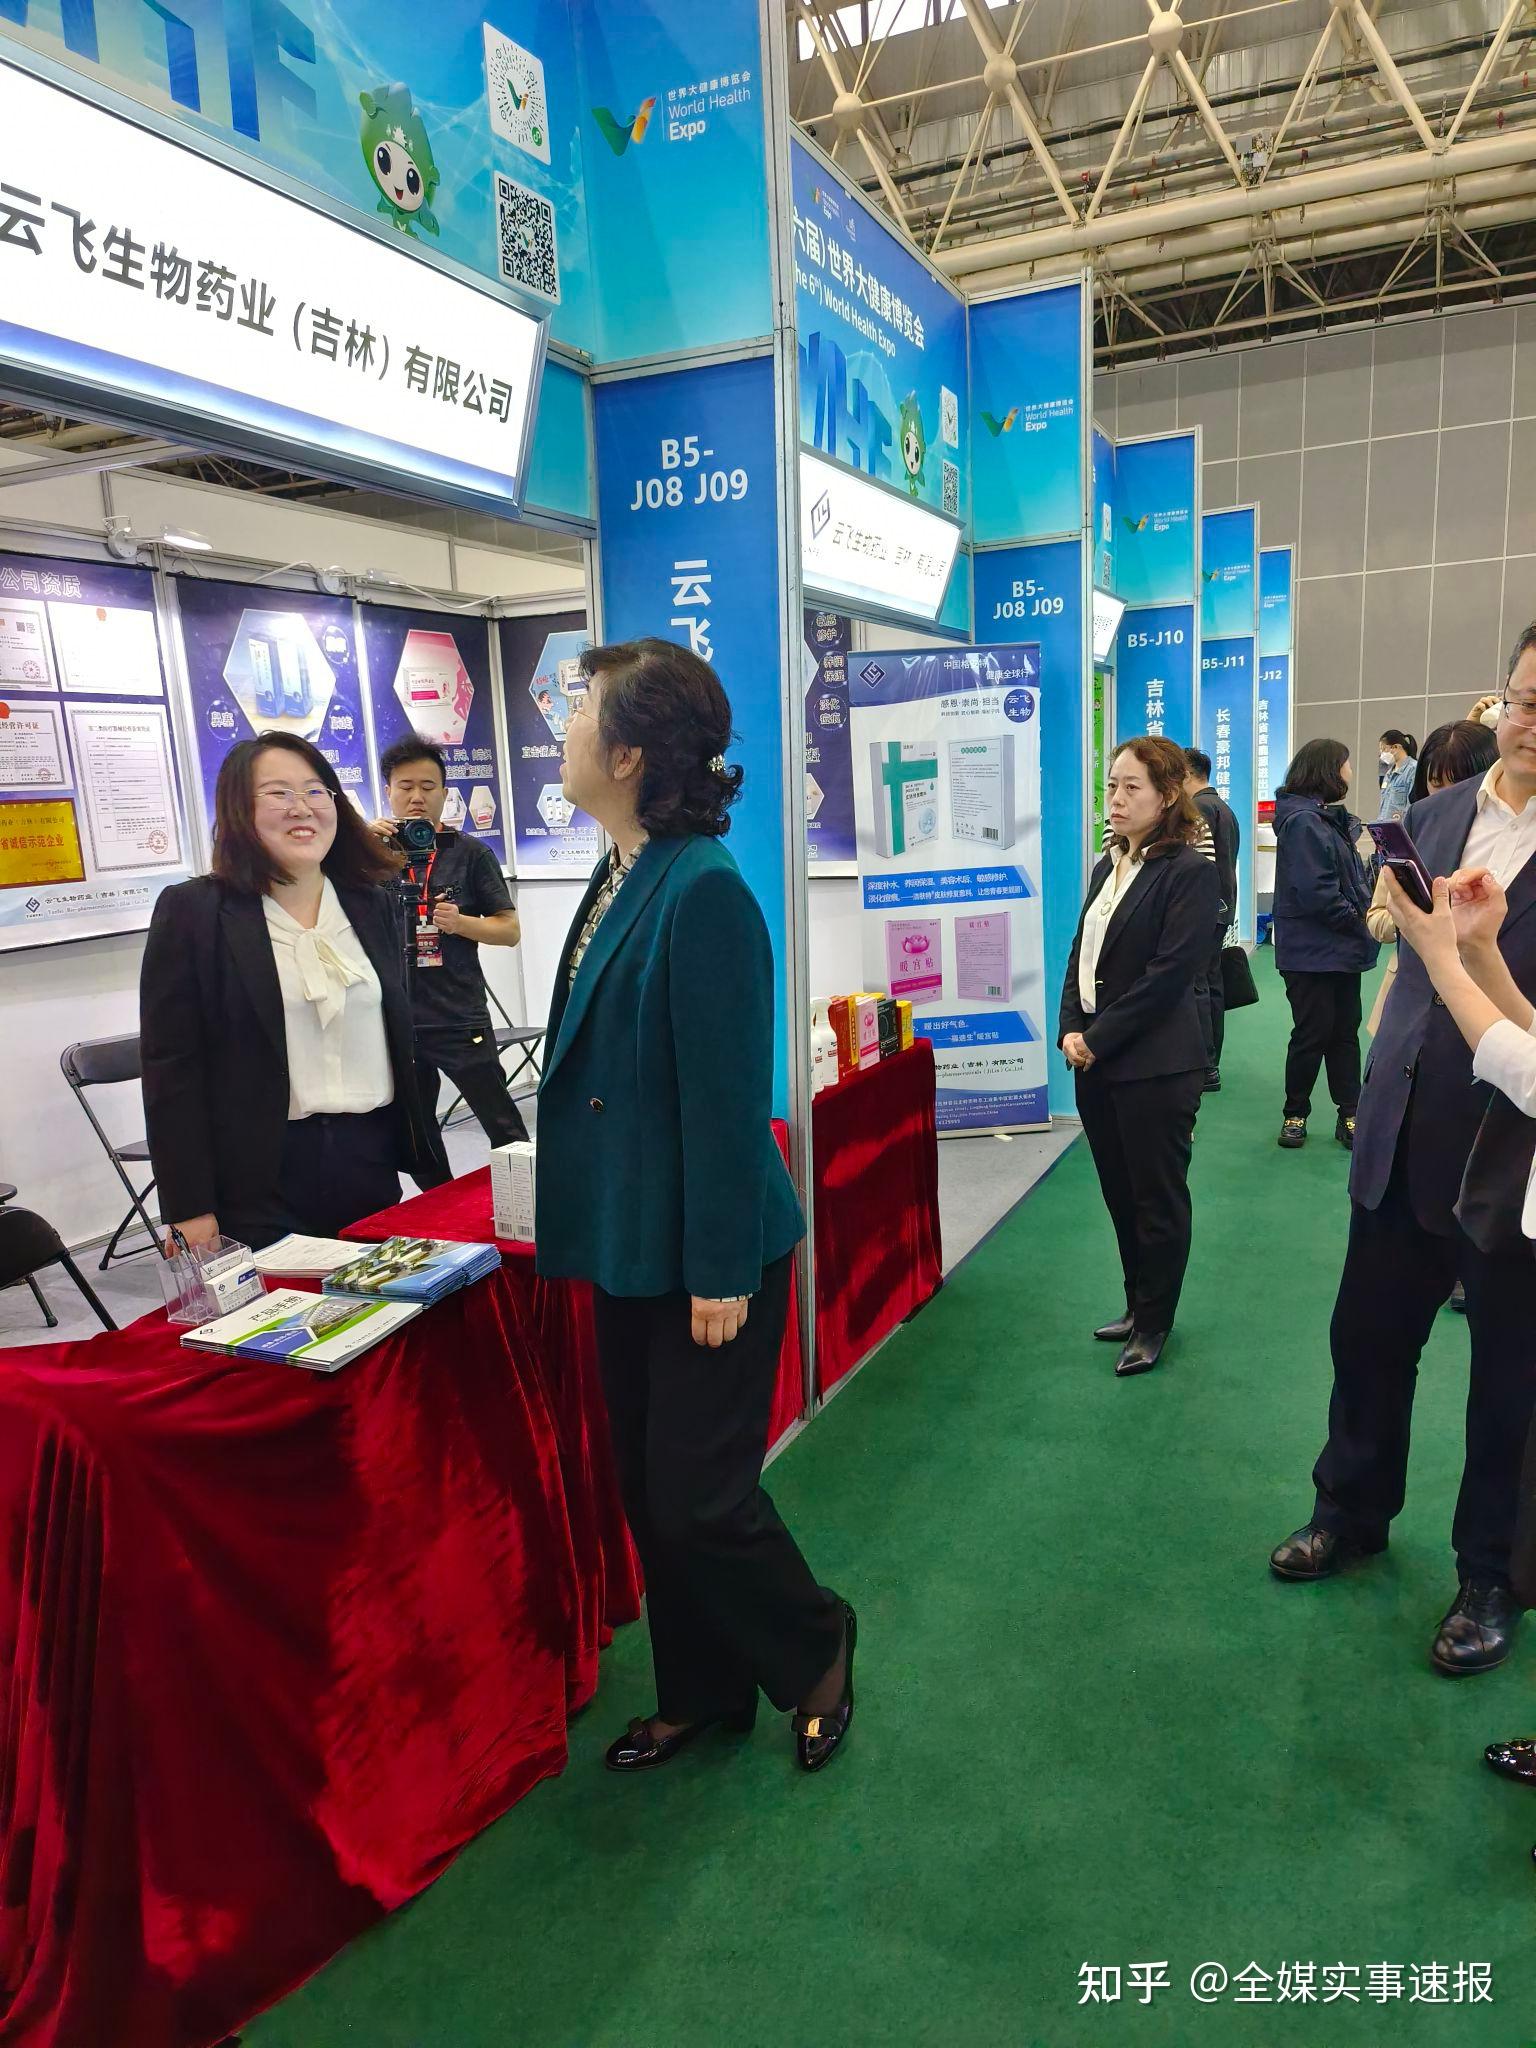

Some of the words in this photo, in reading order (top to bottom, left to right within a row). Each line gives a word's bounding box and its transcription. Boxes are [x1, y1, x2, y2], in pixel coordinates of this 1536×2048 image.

[668, 71, 751, 102] 世界大健康博览会
[668, 99, 705, 120] World
[709, 87, 751, 110] Health
[669, 120, 706, 141] Expo
[0, 183, 513, 423] 云飞生物药业（吉林）有限公司
[824, 284, 851, 323] World
[851, 308, 877, 343] Health
[878, 327, 896, 358] Expo
[1025, 410, 1047, 421] World
[1049, 406, 1074, 417] Health
[1025, 420, 1047, 432] Expo
[661, 436, 714, 470] B5-
[630, 476, 684, 511] J08
[694, 469, 748, 504] J09
[1154, 523, 1169, 531] Expo
[0, 567, 82, 598] 公司资质
[1012, 579, 1045, 598] B5-
[993, 600, 1026, 620] J08
[1031, 597, 1064, 616] J09
[1127, 629, 1185, 648] B5-J10
[1202, 655, 1245, 670] B5-J11
[986, 669, 1029, 681] 健康全球行
[1007, 694, 1031, 704] 云飞
[1007, 706, 1032, 717] 生物
[1215, 708, 1231, 801] 长春豪邦健康
